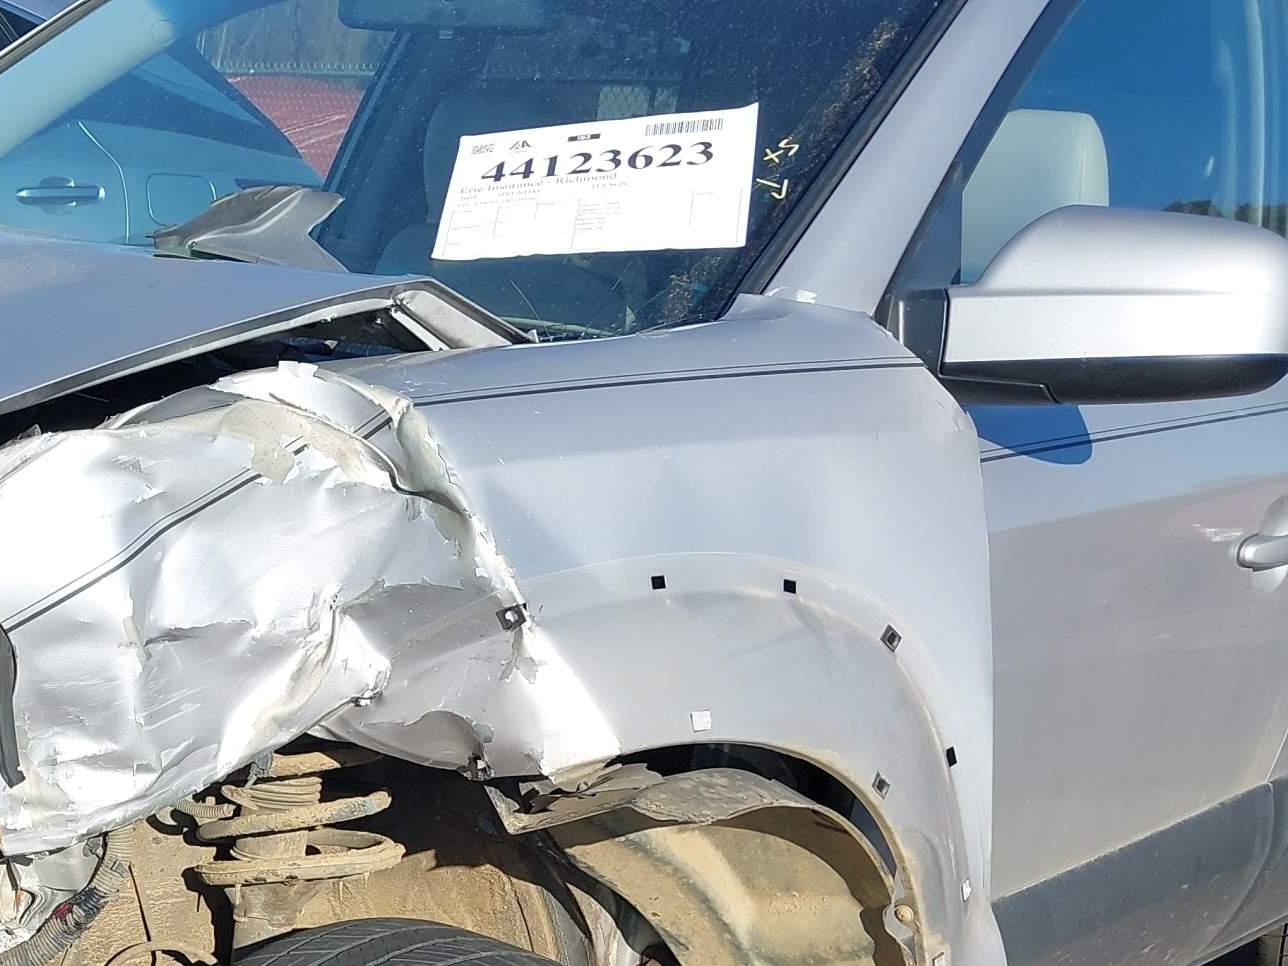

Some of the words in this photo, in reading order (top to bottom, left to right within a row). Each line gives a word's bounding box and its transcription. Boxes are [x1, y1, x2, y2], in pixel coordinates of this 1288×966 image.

[481, 141, 714, 182] 44123623
[460, 186, 484, 195] Erie
[487, 179, 544, 192] Insurance
[555, 172, 618, 185] Richmond
